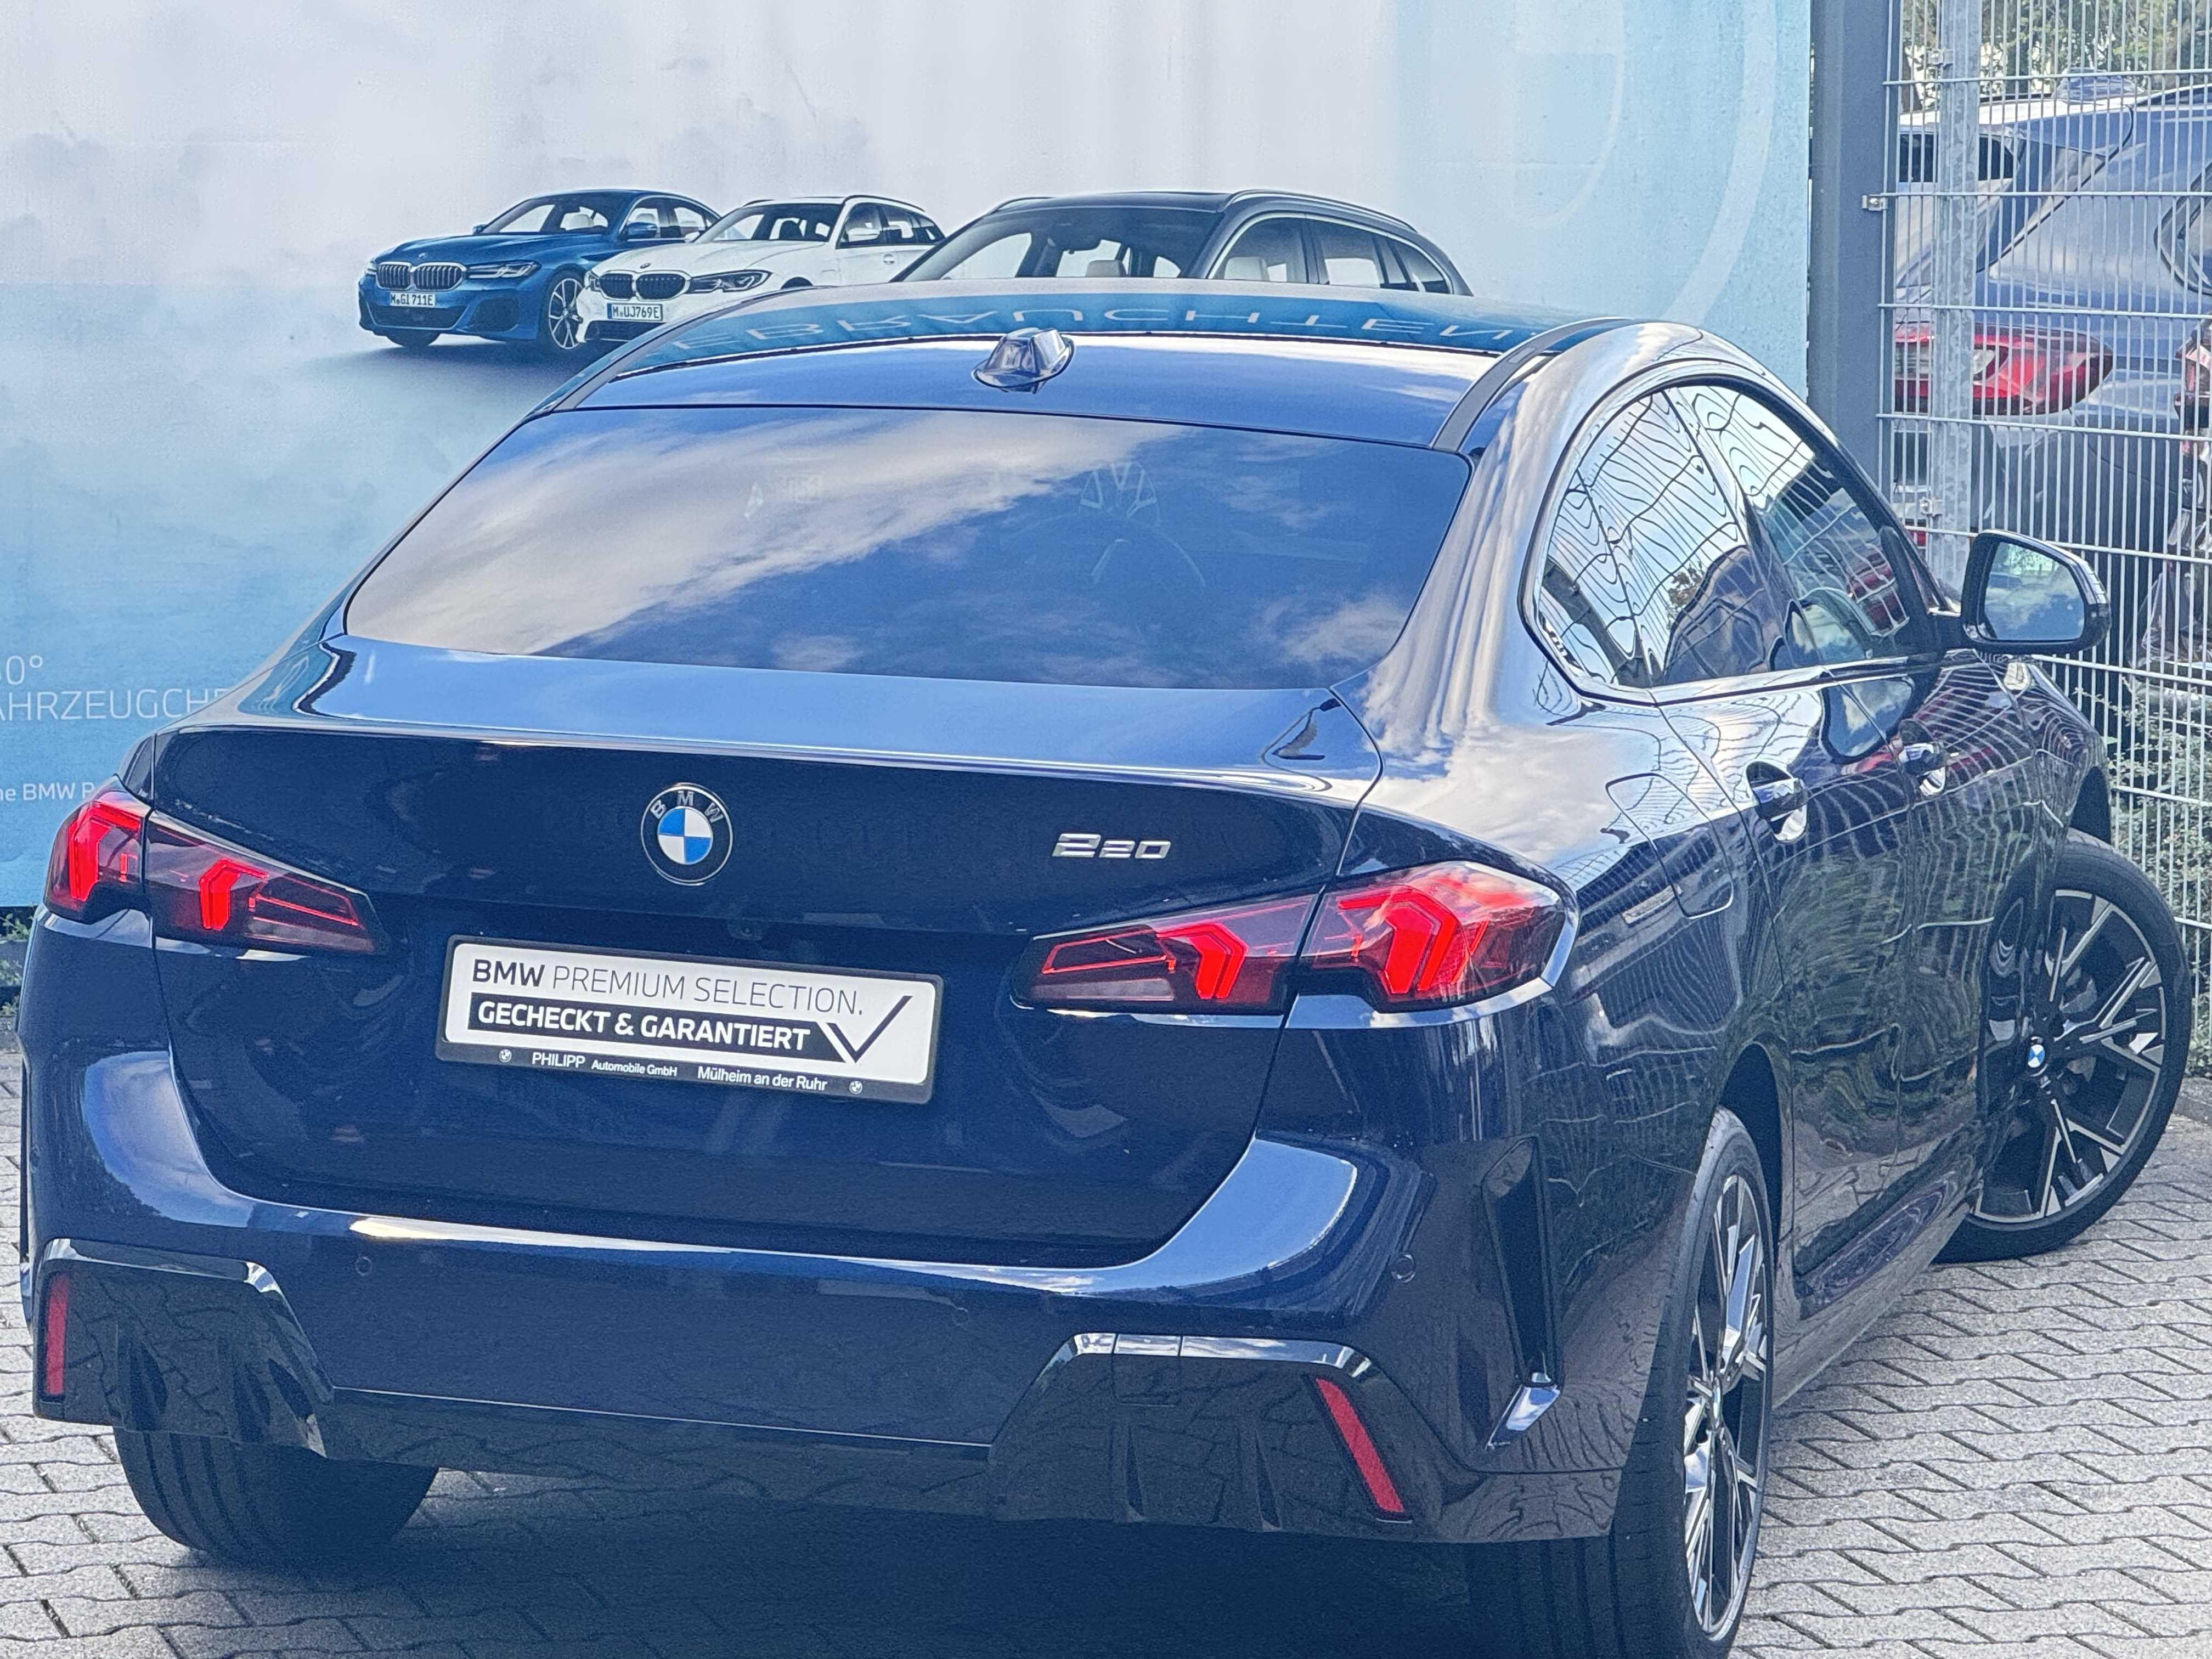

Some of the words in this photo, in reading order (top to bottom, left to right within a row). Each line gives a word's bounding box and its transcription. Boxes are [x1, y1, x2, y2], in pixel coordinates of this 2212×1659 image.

[0, 655, 43, 685] 0°
[0, 689, 229, 720] HRZEUGCH
[23, 782, 76, 801] BMW
[650, 791, 724, 823] BMW
[1052, 833, 1171, 859] 220
[472, 958, 545, 987] BMW
[553, 966, 685, 1000] PREMIUM
[694, 977, 862, 1015] SELECTION.
[478, 1001, 611, 1033] GECHECKT
[614, 1013, 634, 1036] &
[641, 1015, 811, 1051] GARANTIERT
[532, 1052, 585, 1068] PHILIPP
[591, 1059, 645, 1074] Automobile
[647, 1064, 678, 1077] GmbH
[697, 1066, 752, 1084] Mülheim
[754, 1074, 769, 1086] an
[772, 1074, 794, 1087] der
[796, 1075, 828, 1091] Ruhr
